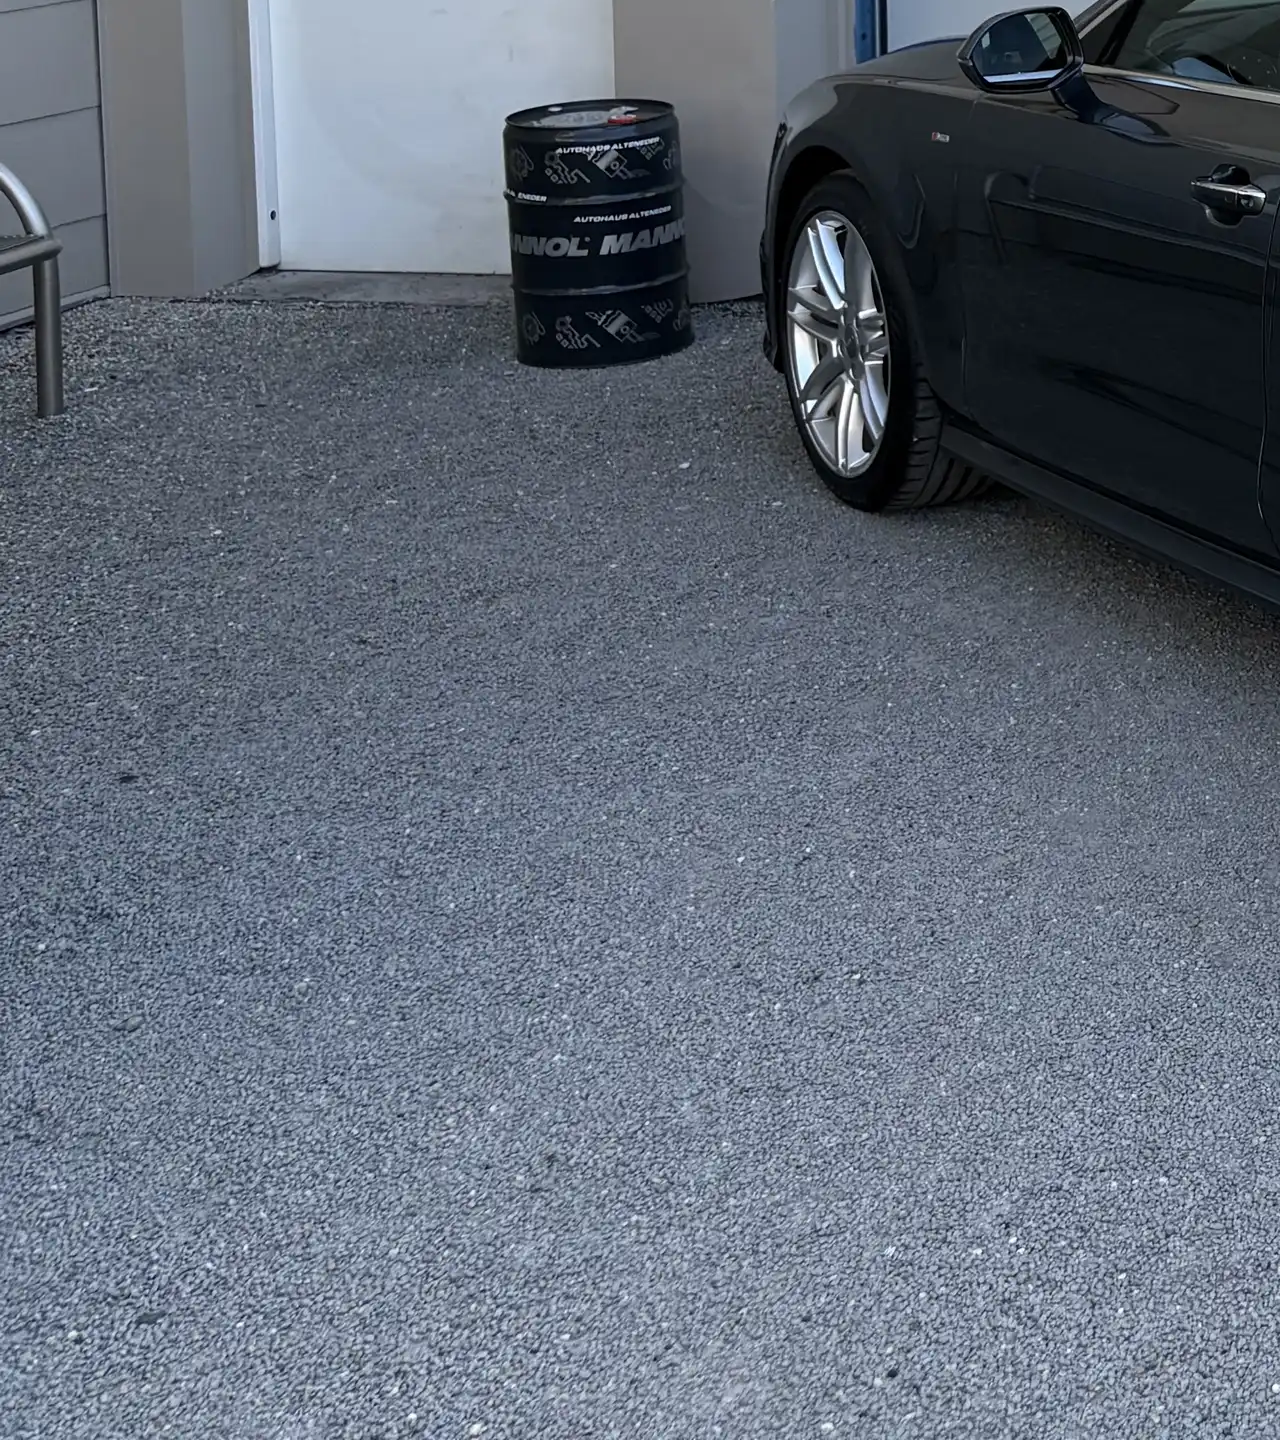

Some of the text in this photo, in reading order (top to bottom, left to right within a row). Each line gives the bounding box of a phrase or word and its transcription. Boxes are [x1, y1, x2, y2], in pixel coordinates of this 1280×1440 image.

[555, 136, 661, 155] AUTOHAUS ALTENEDER
[573, 205, 672, 223] AUTOHAUS ALTENEDER
